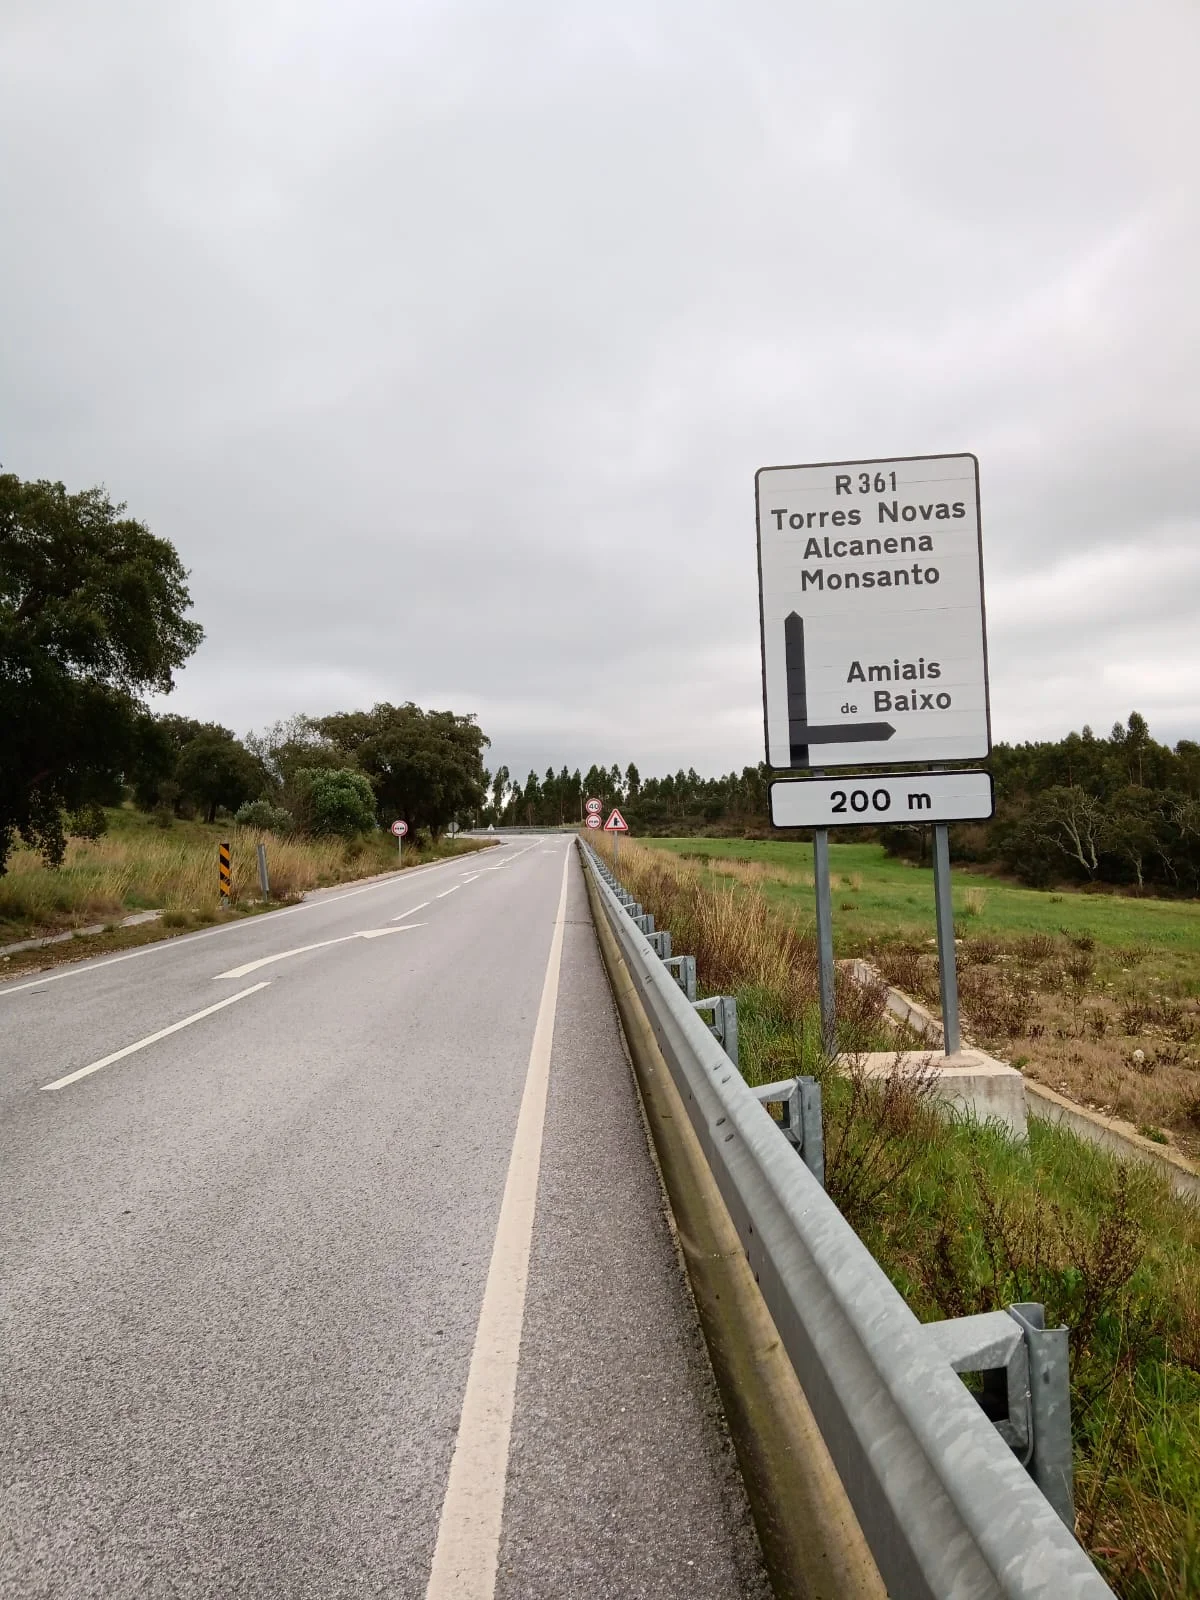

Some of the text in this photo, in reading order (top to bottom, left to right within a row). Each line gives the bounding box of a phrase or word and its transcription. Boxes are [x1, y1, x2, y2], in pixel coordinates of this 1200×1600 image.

[858, 471, 897, 494] 361
[770, 500, 966, 531] Torres Novas
[803, 535, 934, 560] Alcanena
[801, 563, 940, 592] Monsanto
[846, 657, 941, 683] Amiais
[840, 688, 952, 714] de Baixo
[830, 788, 932, 813] 200 m
